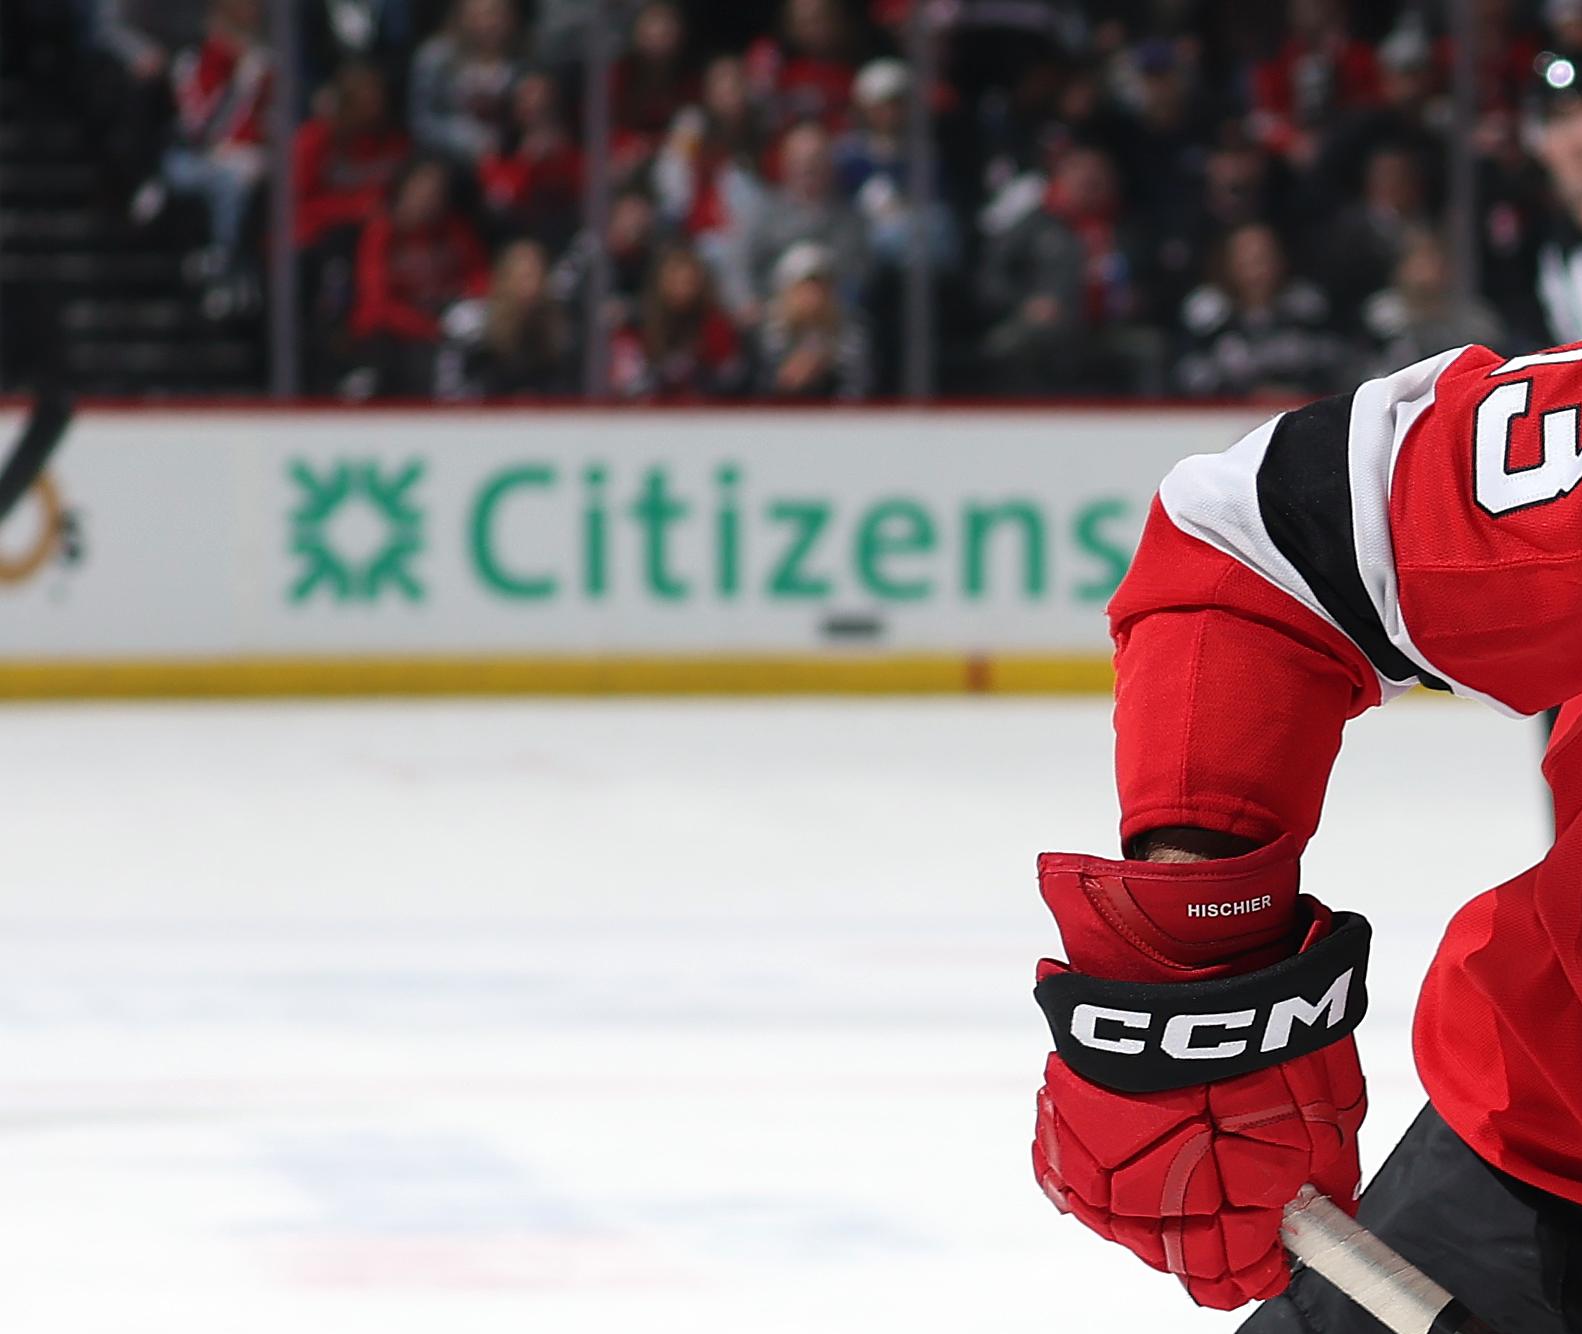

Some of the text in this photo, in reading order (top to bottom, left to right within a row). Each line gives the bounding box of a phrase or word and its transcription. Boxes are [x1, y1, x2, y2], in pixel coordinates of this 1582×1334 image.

[468, 463, 1137, 603] Citizens
[1187, 894, 1272, 918] HISCHIER
[1069, 966, 1354, 1060] CCM
